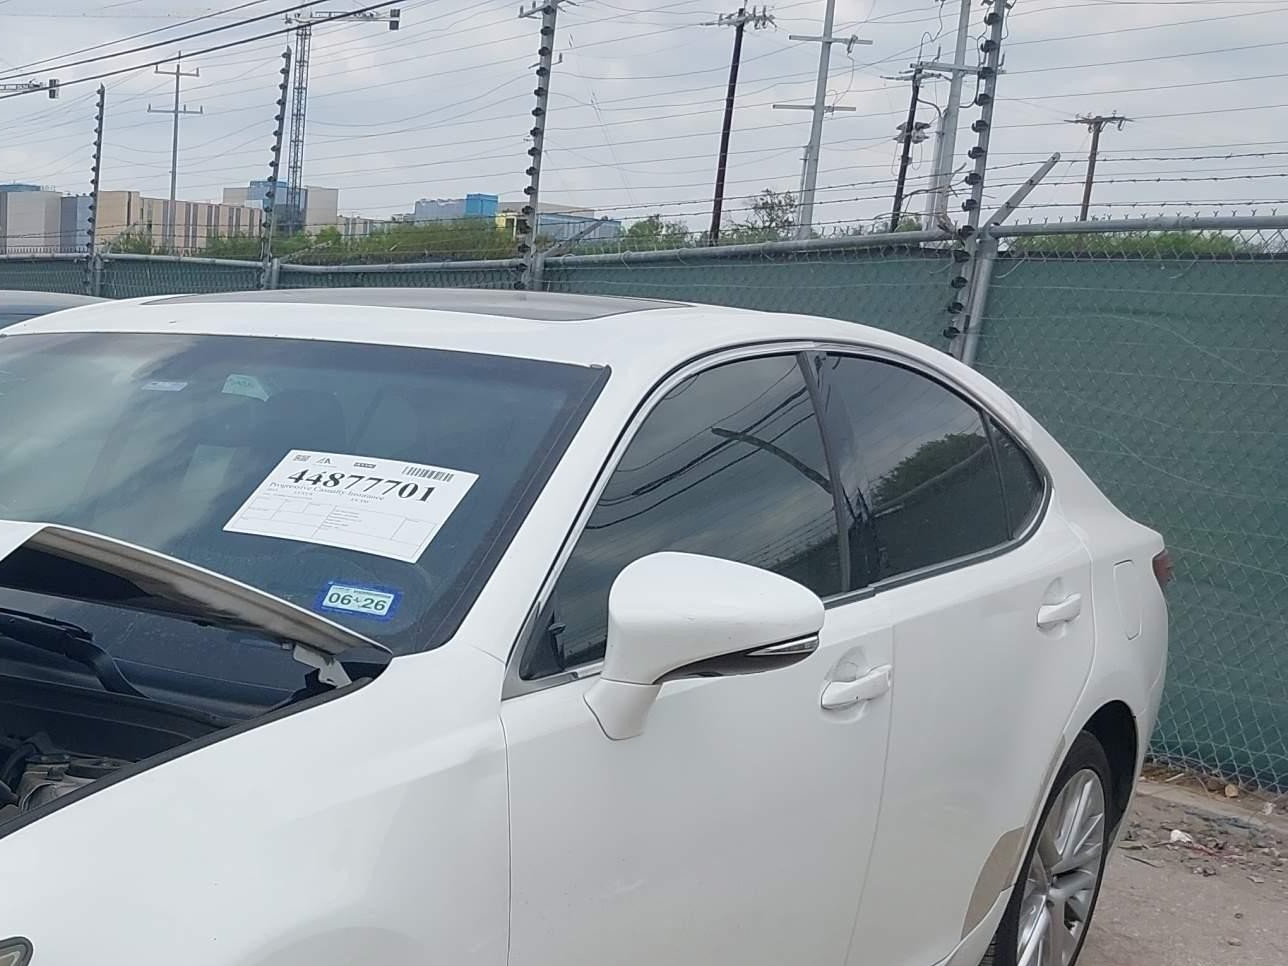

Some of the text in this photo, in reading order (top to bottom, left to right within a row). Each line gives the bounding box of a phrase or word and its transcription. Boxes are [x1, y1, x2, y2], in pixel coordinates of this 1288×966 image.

[288, 469, 435, 502] 44877701
[328, 592, 352, 606] 06
[362, 597, 387, 611] 26
